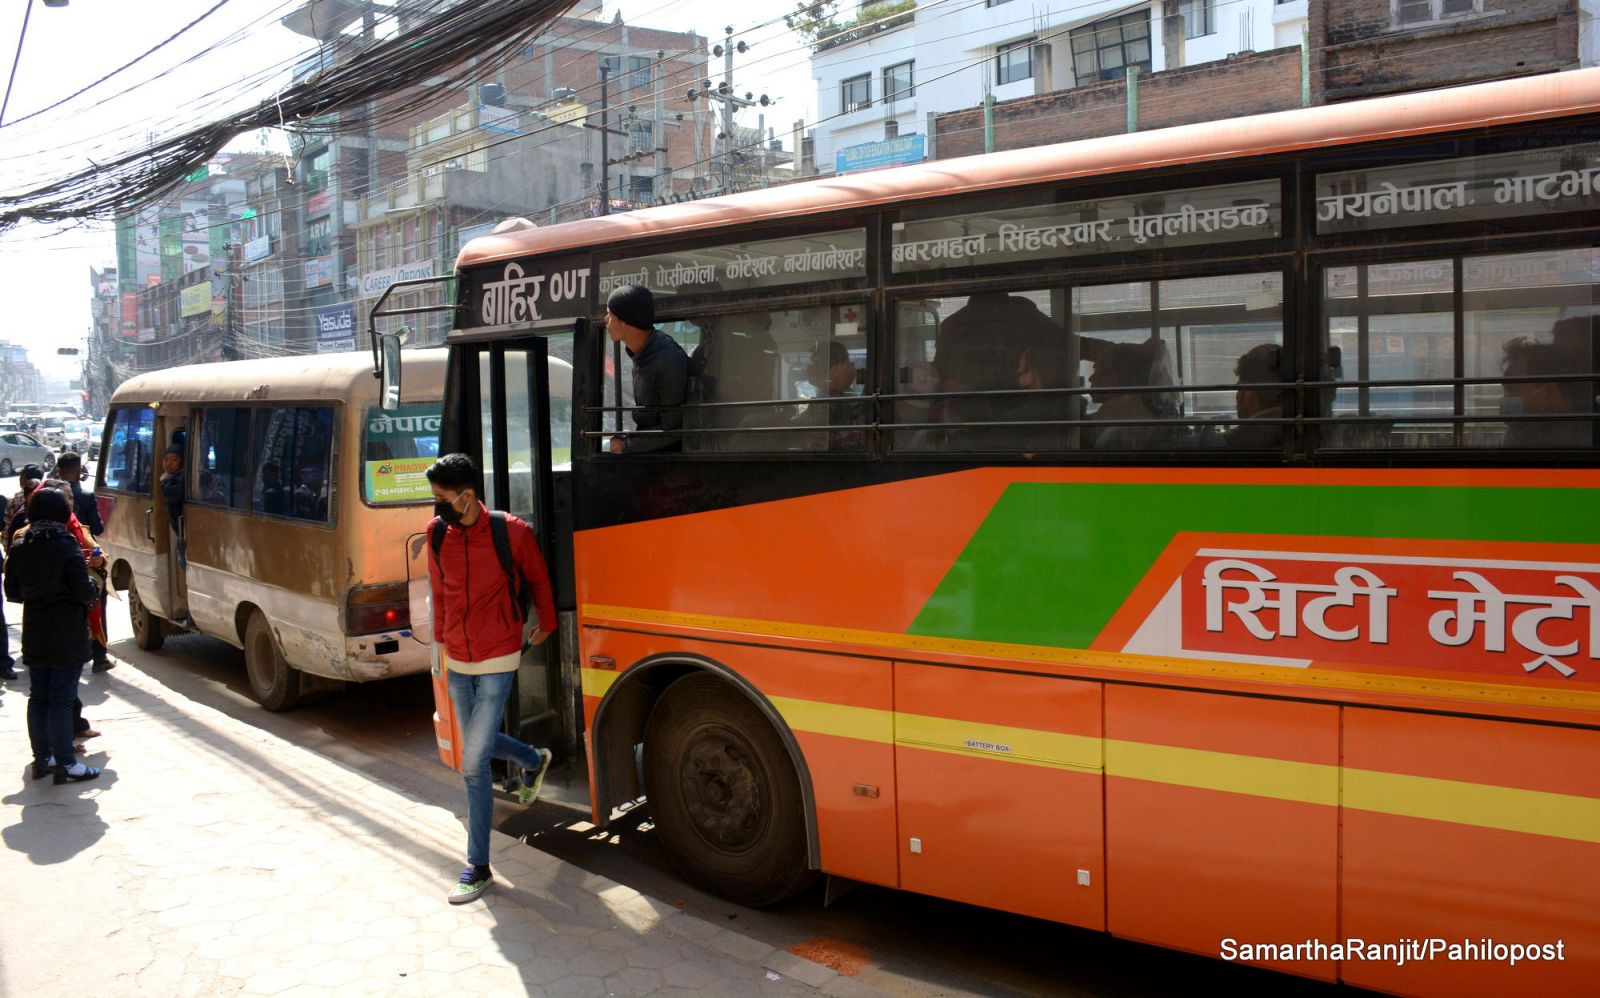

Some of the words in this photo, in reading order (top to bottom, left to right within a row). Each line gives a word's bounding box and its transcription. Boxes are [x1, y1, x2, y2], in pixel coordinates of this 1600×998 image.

[310, 220, 331, 240] ARYA
[1129, 203, 1270, 244] पुतलीसडक
[364, 274, 391, 292] CAREER
[398, 266, 431, 281] OPTIONS
[550, 268, 590, 303] OUT
[482, 262, 545, 326] बाहिर
[318, 310, 351, 332] Yasuda
[394, 463, 428, 472] PRAGYA
[1202, 559, 1397, 644] सिटी
[967, 740, 995, 750] BATTERY
[995, 744, 1009, 752] BOX
